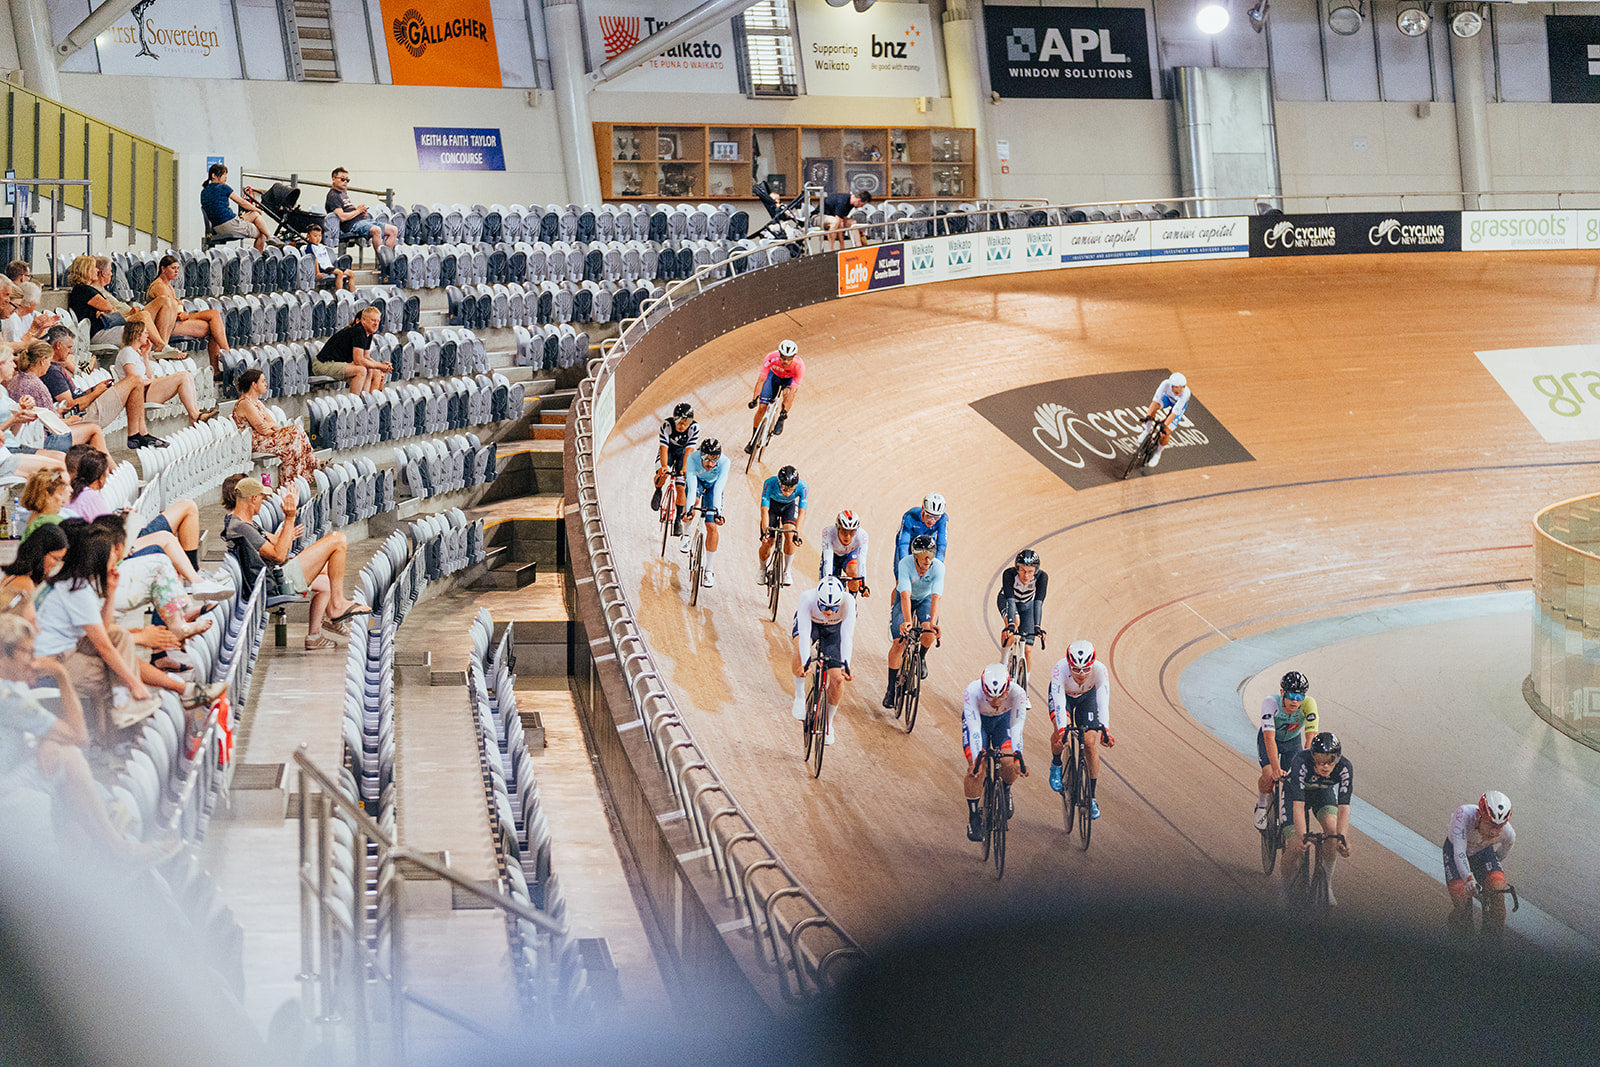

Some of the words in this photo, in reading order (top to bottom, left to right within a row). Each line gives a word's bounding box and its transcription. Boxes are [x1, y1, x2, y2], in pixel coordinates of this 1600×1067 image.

[146, 18, 219, 57] Sovereign
[408, 18, 488, 45] GALLAGHER
[660, 41, 722, 58] aikato
[812, 42, 858, 57] Supporting
[871, 34, 907, 59] bnz
[1038, 28, 1126, 62] APL
[649, 60, 659, 68] TE
[661, 60, 681, 69] PUNA
[683, 61, 688, 69] O
[690, 61, 724, 70] WAIKATO
[815, 59, 850, 71] Waikato
[1008, 68, 1060, 78] WINDOW
[1064, 68, 1133, 79] SOLUTIONS
[421, 134, 441, 146] KEITH
[442, 134, 448, 146] &
[449, 135, 469, 146] FAITH
[470, 135, 497, 147] TAYLOR
[440, 152, 483, 164] CONCOURSE
[1199, 222, 1236, 243] capital
[1295, 226, 1336, 240] CYCLING
[1401, 224, 1445, 237] CYCLING
[1470, 213, 1566, 243] grassroots
[986, 235, 1011, 246] Waikato
[1026, 232, 1052, 243] Waikato
[1104, 227, 1139, 248] capital
[1294, 239, 1309, 247] NEW
[1310, 238, 1336, 247] ZEALAND
[1401, 236, 1417, 245] NEW
[1418, 236, 1445, 245] ZEALAND
[911, 244, 934, 255] Waikato
[948, 240, 972, 251] Waikato
[845, 263, 868, 284] Lotto
